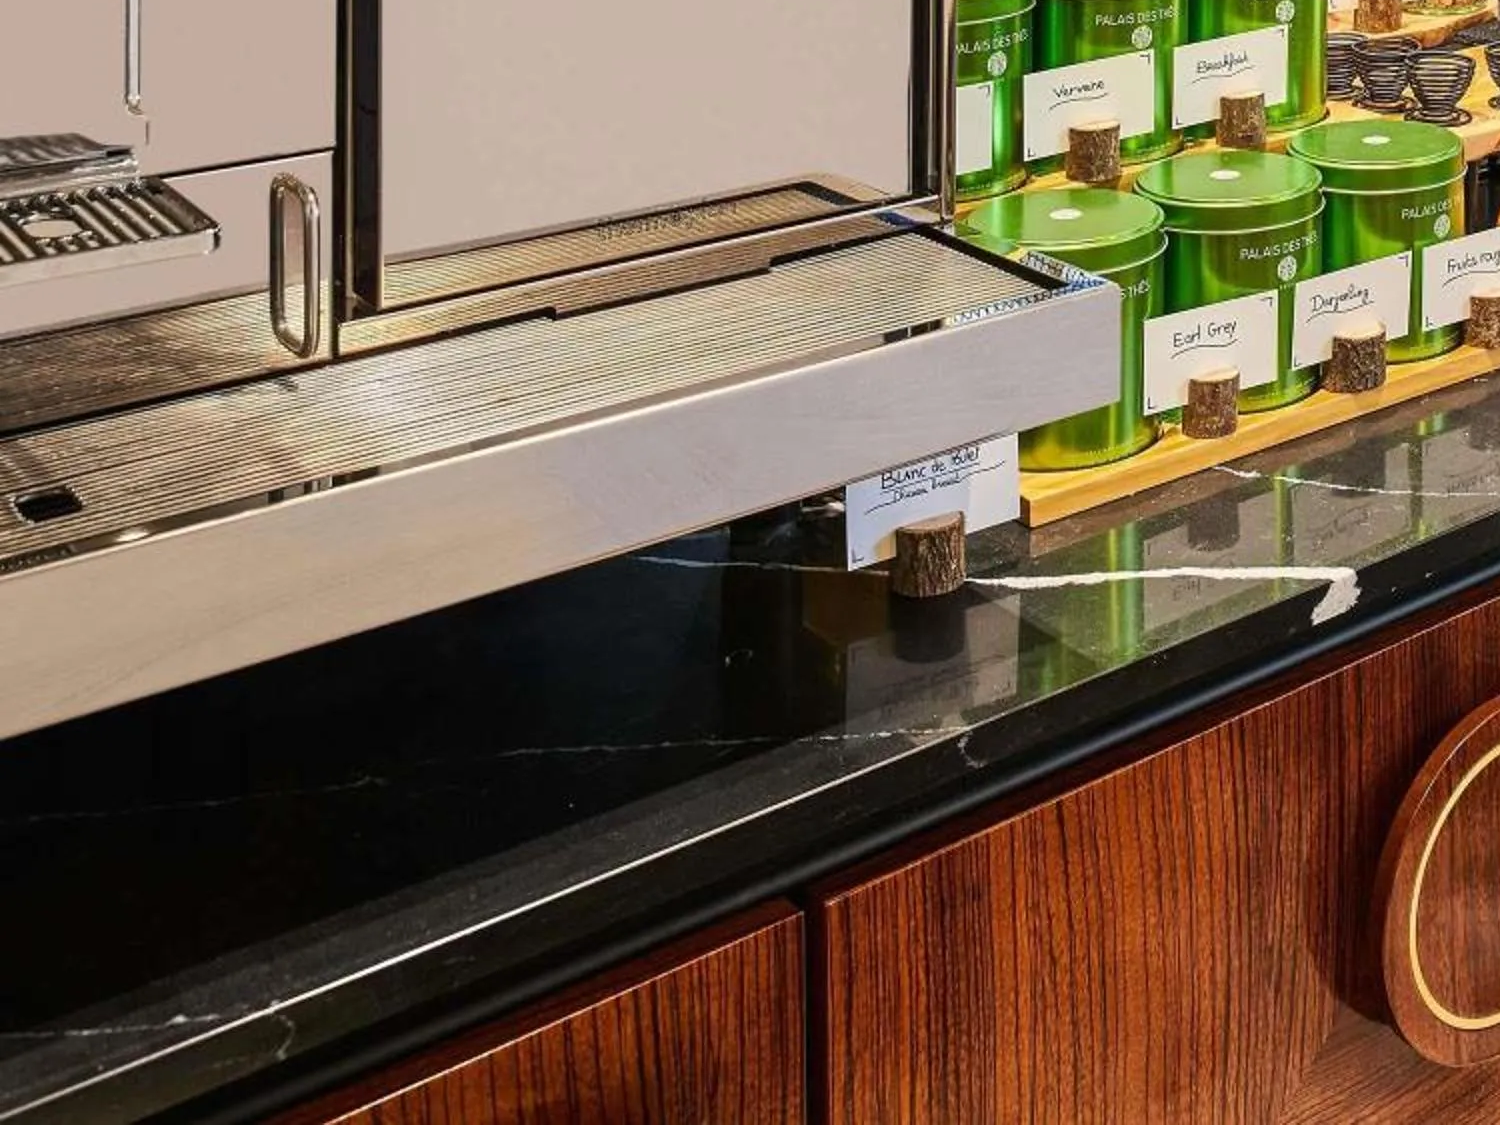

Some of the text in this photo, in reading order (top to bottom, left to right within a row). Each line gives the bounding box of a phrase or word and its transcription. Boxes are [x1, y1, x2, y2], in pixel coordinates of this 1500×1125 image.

[1095, 12, 1135, 26] PALAIS
[955, 39, 991, 54] ALAIS
[1401, 201, 1437, 220] PALAIS
[1240, 244, 1281, 260] PALAIS
[1173, 320, 1237, 348] Earl Grey
